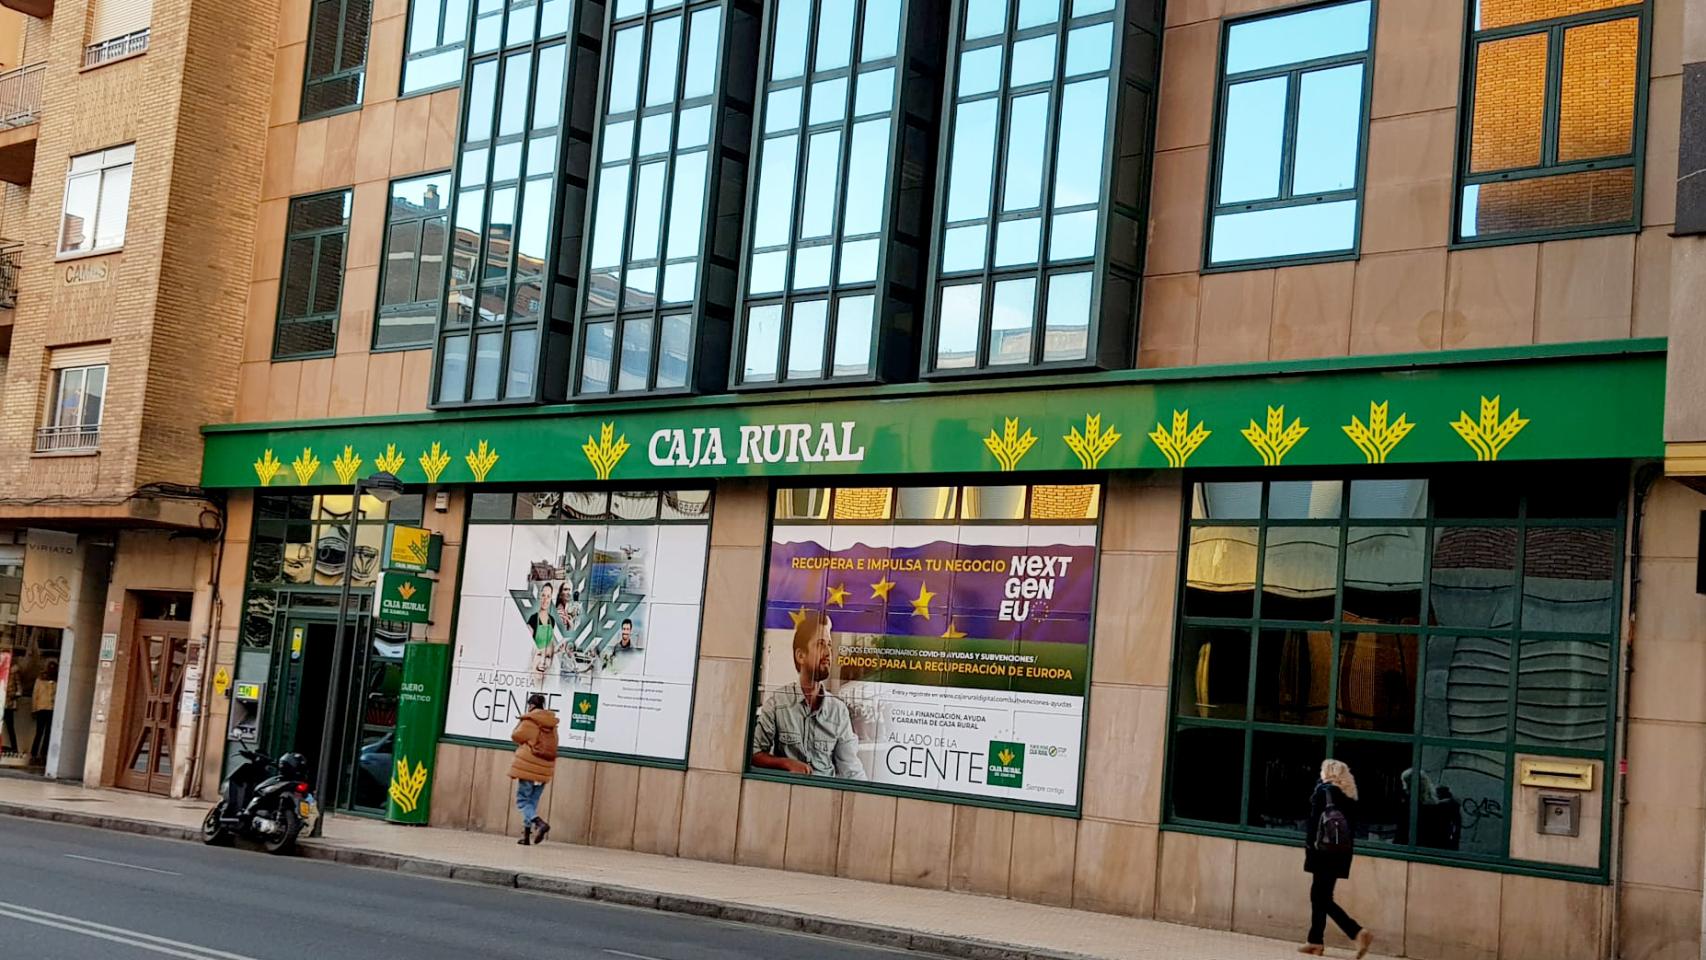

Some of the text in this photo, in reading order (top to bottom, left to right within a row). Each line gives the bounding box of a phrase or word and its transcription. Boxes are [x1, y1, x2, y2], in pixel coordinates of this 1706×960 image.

[648, 421, 865, 468] CAJA RURAL
[29, 543, 73, 554] VIRIATO
[792, 557, 1006, 572] RECUPERA E IMPULSA TU NEGOCIO
[383, 599, 427, 612] CAJA RURAL
[998, 600, 1030, 622] EU
[838, 645, 862, 656] FONDOS
[863, 646, 918, 657] EXTRAORDINARIOS
[946, 651, 974, 660] AYUDAS
[974, 652, 981, 660] Y
[837, 656, 1073, 680] FONDOS PARA LA RECUPERACIÓN DE EUROPA
[477, 672, 535, 688] AL LADO DE LA
[891, 708, 906, 716] CON
[963, 714, 986, 722] AYUDA
[929, 718, 938, 726] DE
[939, 720, 956, 728] CAJA
[957, 721, 979, 730] RURAL
[888, 731, 958, 748] AL LADO DE LA
[885, 744, 985, 784] GENTE
